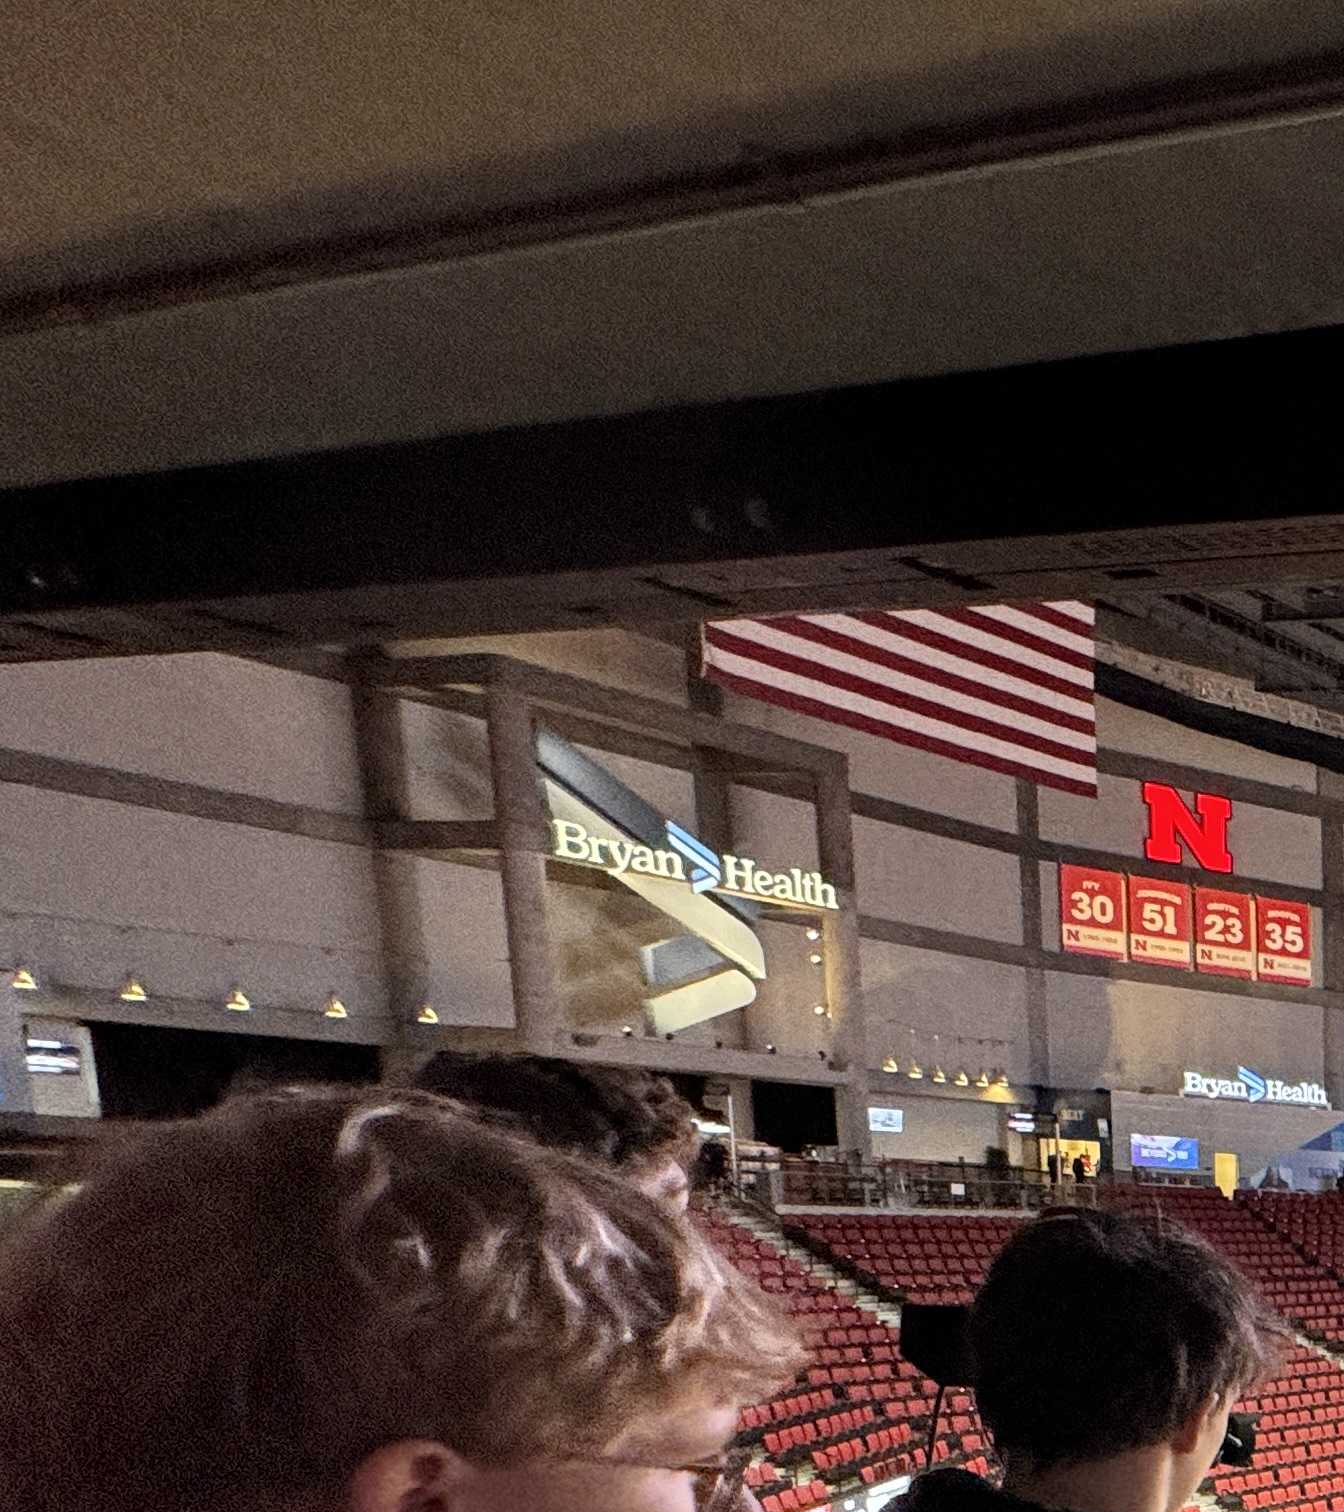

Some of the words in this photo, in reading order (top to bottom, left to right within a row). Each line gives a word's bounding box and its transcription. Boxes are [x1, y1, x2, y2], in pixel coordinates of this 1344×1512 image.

[1143, 782, 1232, 873] N
[552, 818, 686, 876] Bryan
[722, 854, 839, 910] Health
[1070, 891, 1114, 924] 30
[1141, 903, 1178, 935] 51
[1203, 914, 1244, 945] 23
[1264, 922, 1304, 953] 35
[1183, 1071, 1248, 1099] Bryan
[1265, 1079, 1328, 1105] Health
